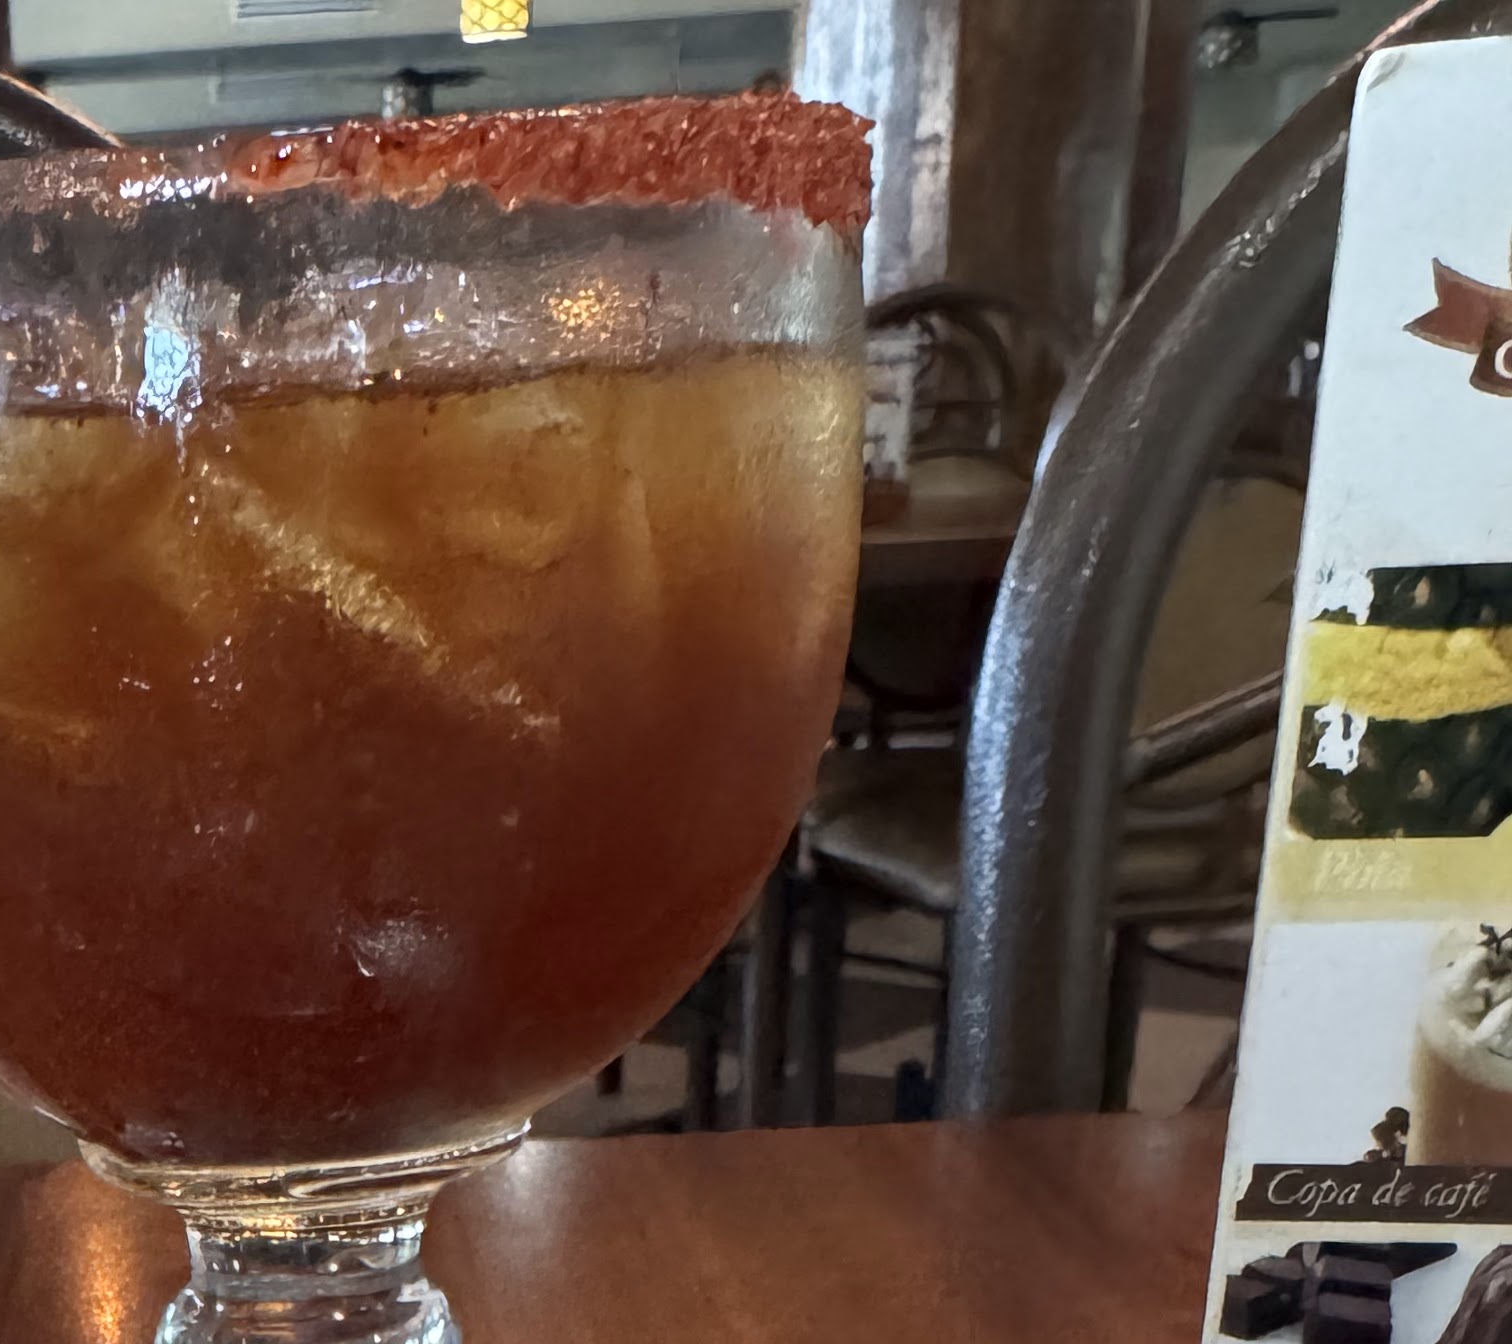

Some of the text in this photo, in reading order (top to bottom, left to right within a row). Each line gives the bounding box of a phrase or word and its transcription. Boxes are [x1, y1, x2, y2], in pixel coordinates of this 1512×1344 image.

[1267, 1168, 1497, 1219] Copa de café
